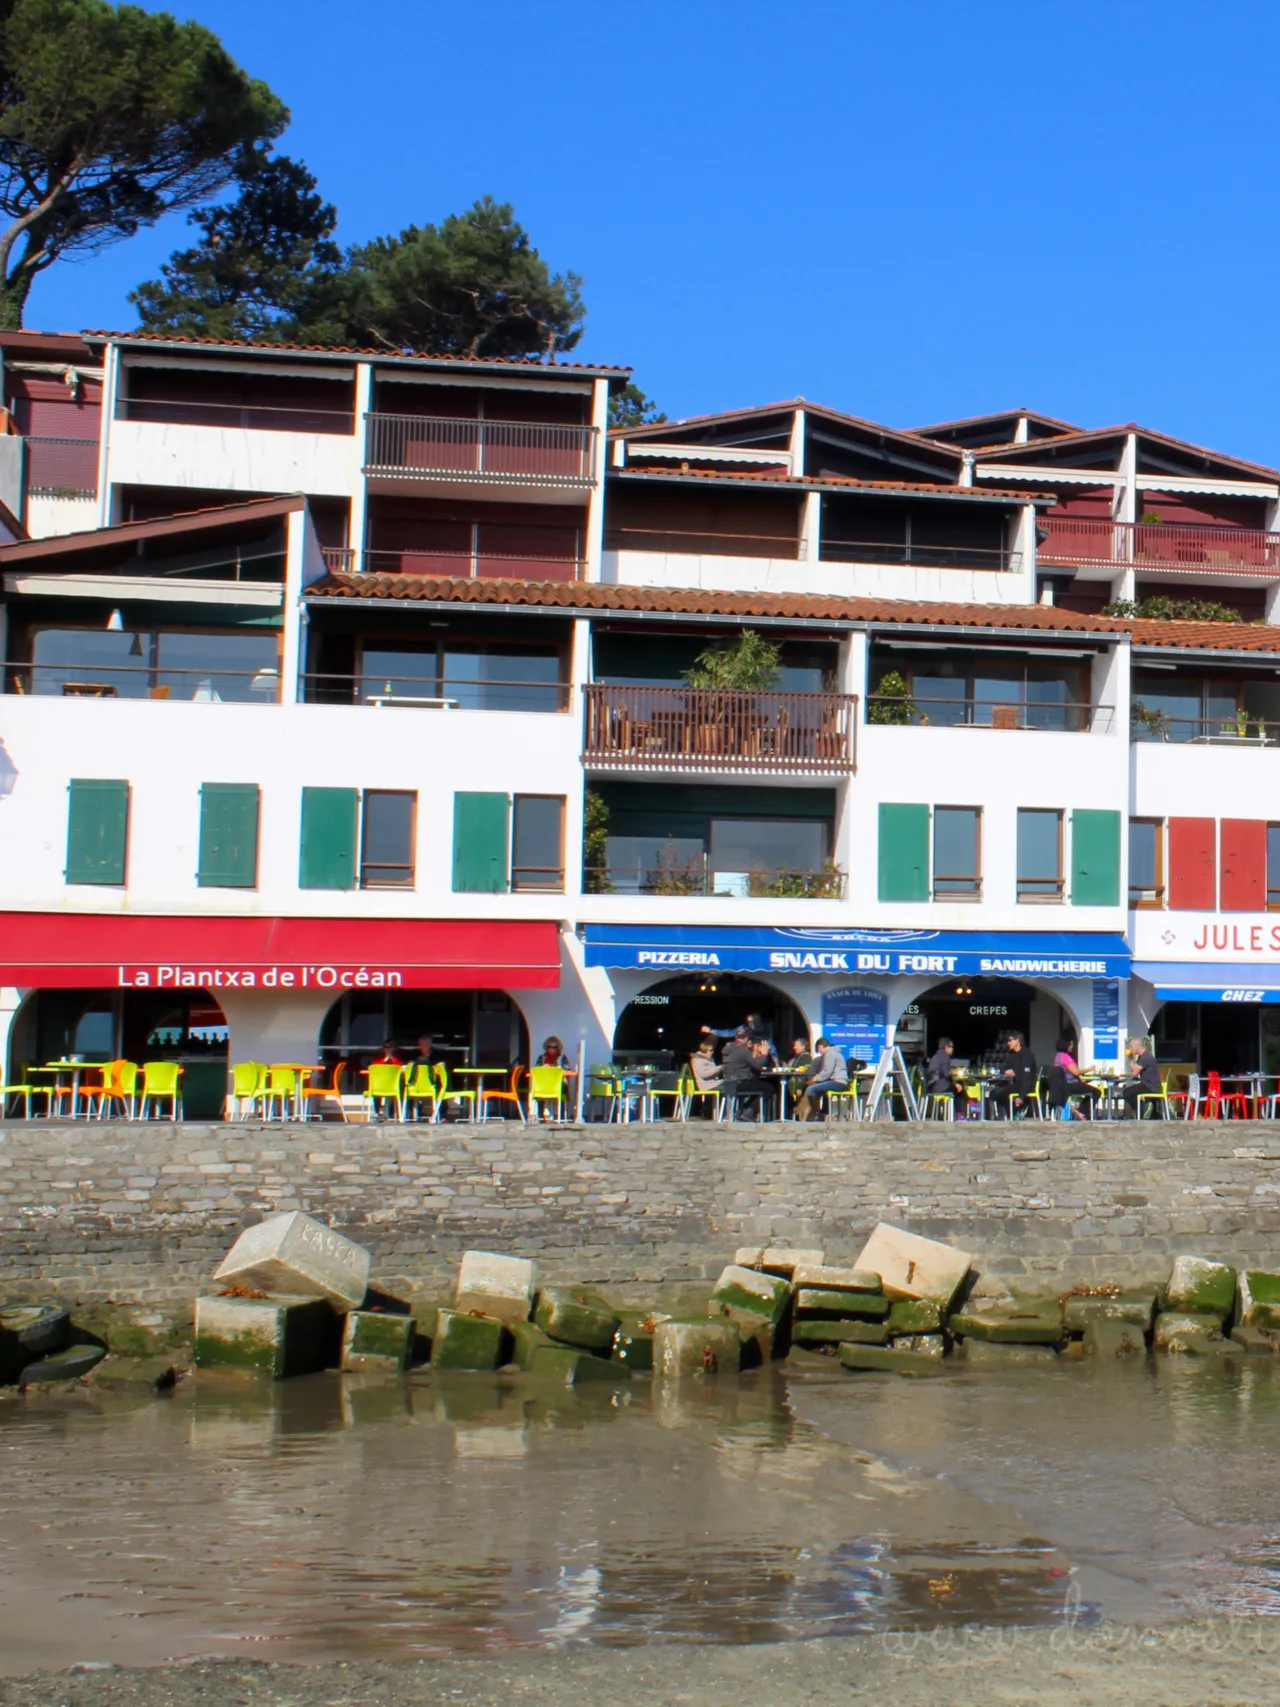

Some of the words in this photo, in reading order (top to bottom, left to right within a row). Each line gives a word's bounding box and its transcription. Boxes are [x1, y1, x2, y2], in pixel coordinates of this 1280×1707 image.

[638, 951, 720, 965] PIZZERIA
[770, 952, 849, 969] SNACK
[857, 953, 890, 970] DU
[899, 954, 958, 971] FORT
[980, 959, 1106, 973] SANDWICHERIE
[118, 966, 149, 986] La
[157, 966, 255, 986] Plantxa
[262, 966, 294, 986] de
[302, 966, 401, 986] l'Océan
[1221, 990, 1264, 1002] CHEZ
[970, 1006, 1007, 1015] CREPES
